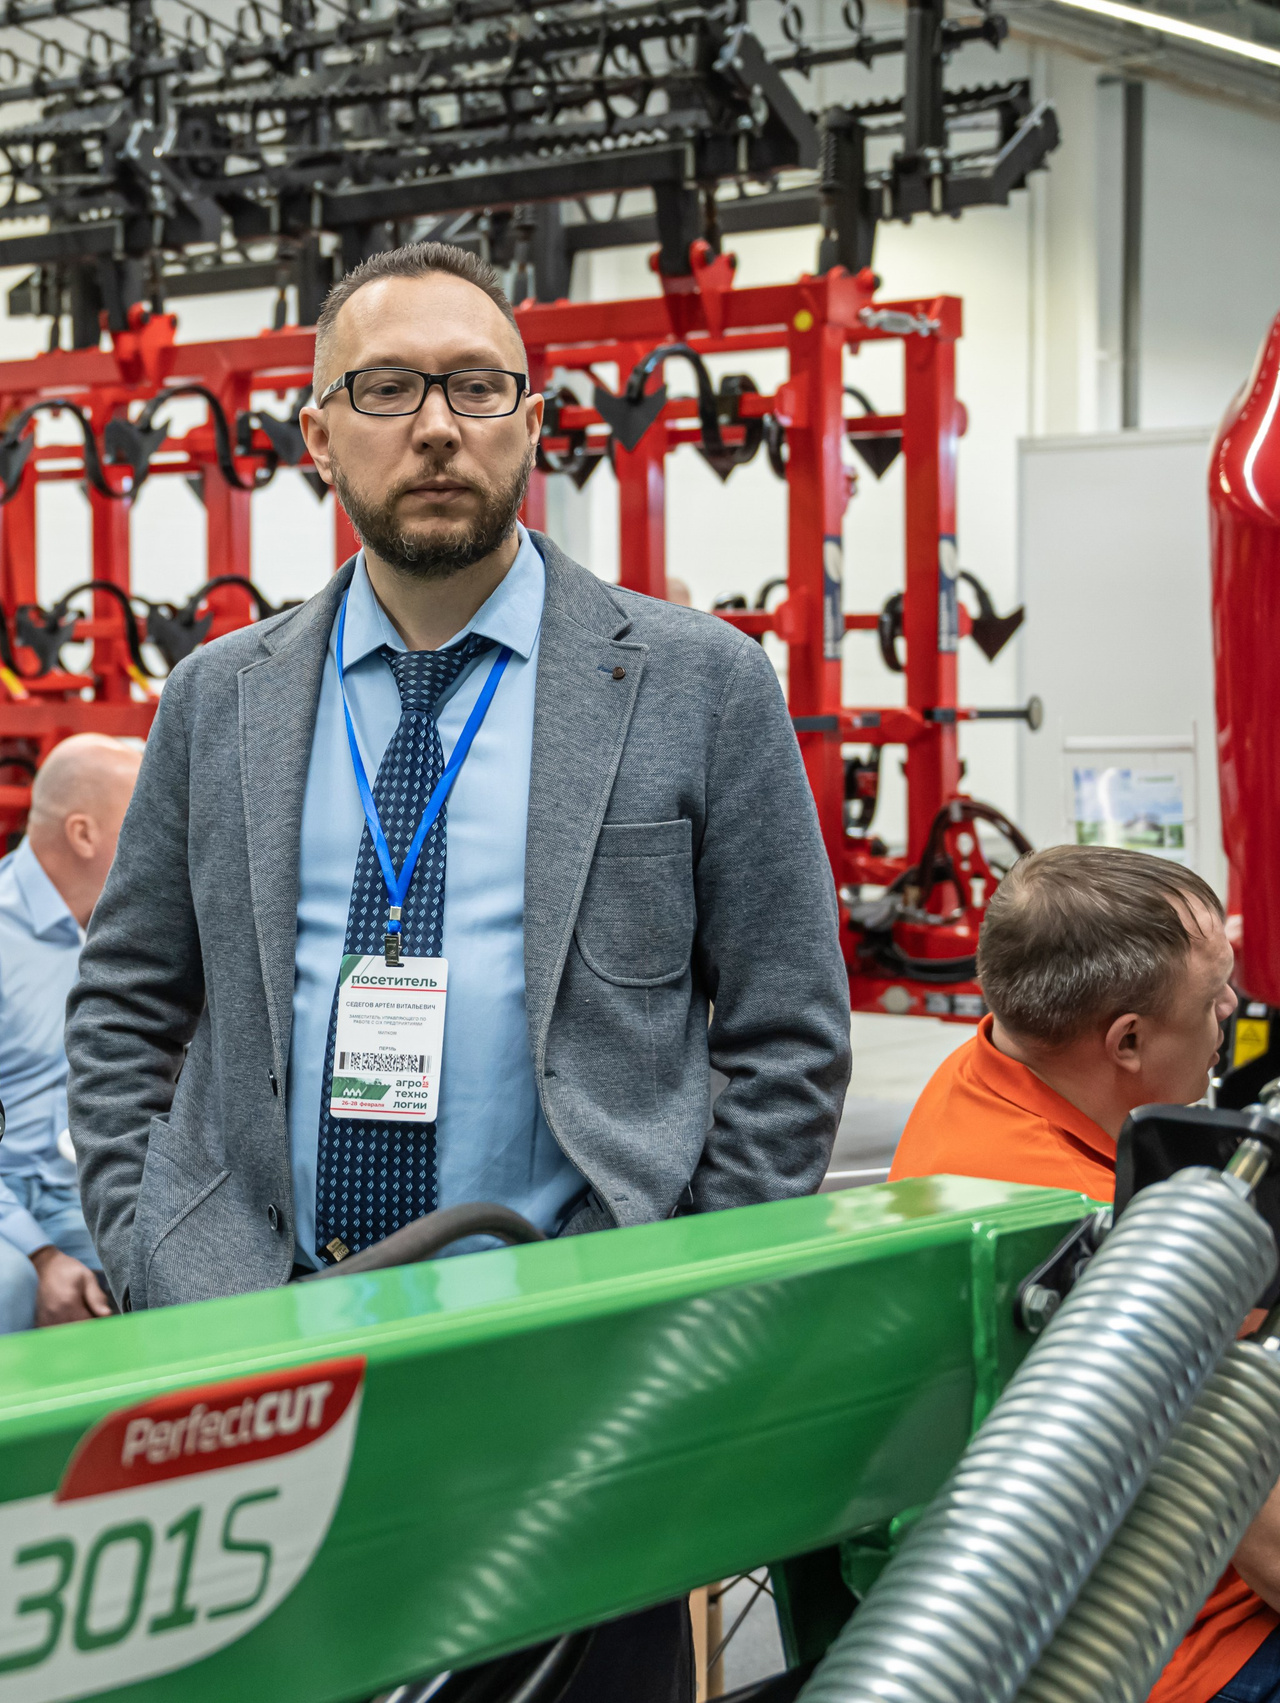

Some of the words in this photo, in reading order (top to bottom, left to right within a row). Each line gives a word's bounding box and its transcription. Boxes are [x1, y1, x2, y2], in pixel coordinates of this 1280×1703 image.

[351, 975, 438, 988] посетитель
[395, 1079, 422, 1089] агро
[395, 1090, 429, 1099] техно
[393, 1101, 428, 1109] логии
[122, 1380, 334, 1468] PerfectCUT
